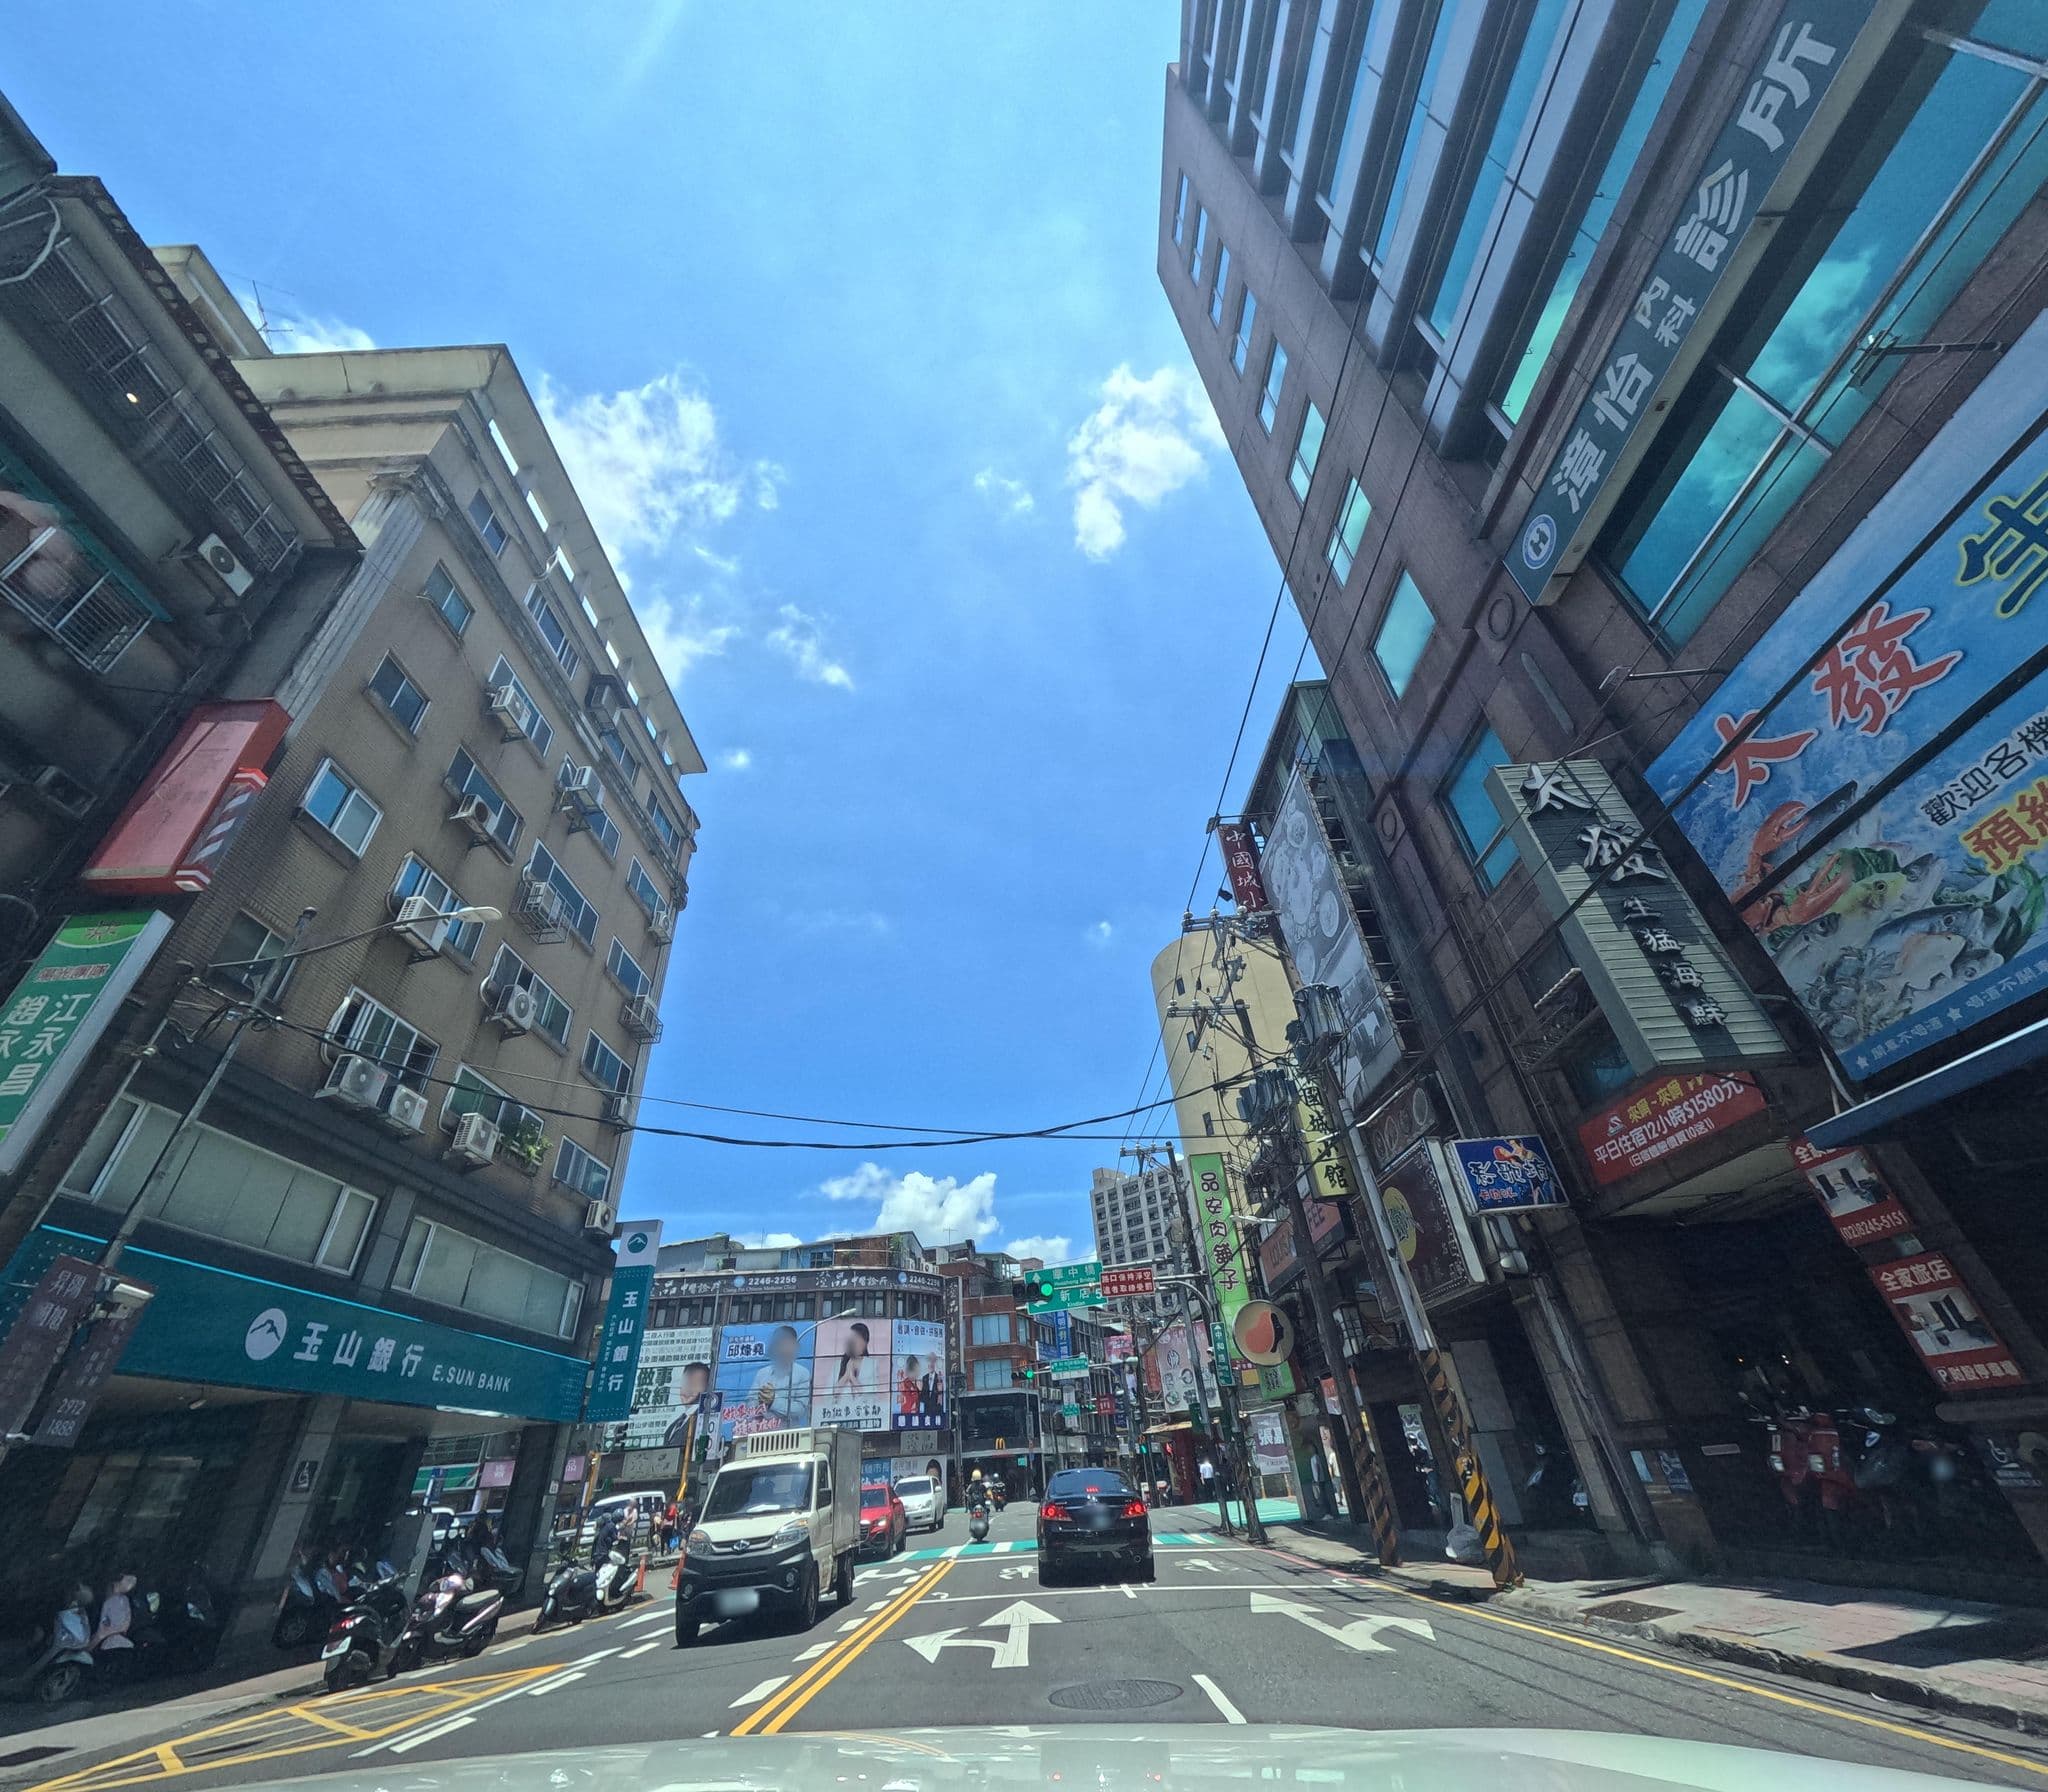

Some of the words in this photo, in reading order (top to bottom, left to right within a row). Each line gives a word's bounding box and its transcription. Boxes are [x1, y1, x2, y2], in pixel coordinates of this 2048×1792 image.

[2, 994, 91, 1096] 江永昌
[1594, 1073, 1744, 1165] 平日住宿12小時$1580元
[1840, 1210, 1908, 1240] (02)8245-5151
[1880, 1260, 1953, 1292] 全家旅店
[293, 1321, 424, 1378] 玉山銀行
[608, 1290, 639, 1392] 玉山銀行
[432, 1364, 475, 1387] E.SUN
[478, 1372, 512, 1393] BANK
[637, 1366, 673, 1387] 做事
[634, 1387, 671, 1406] 政績
